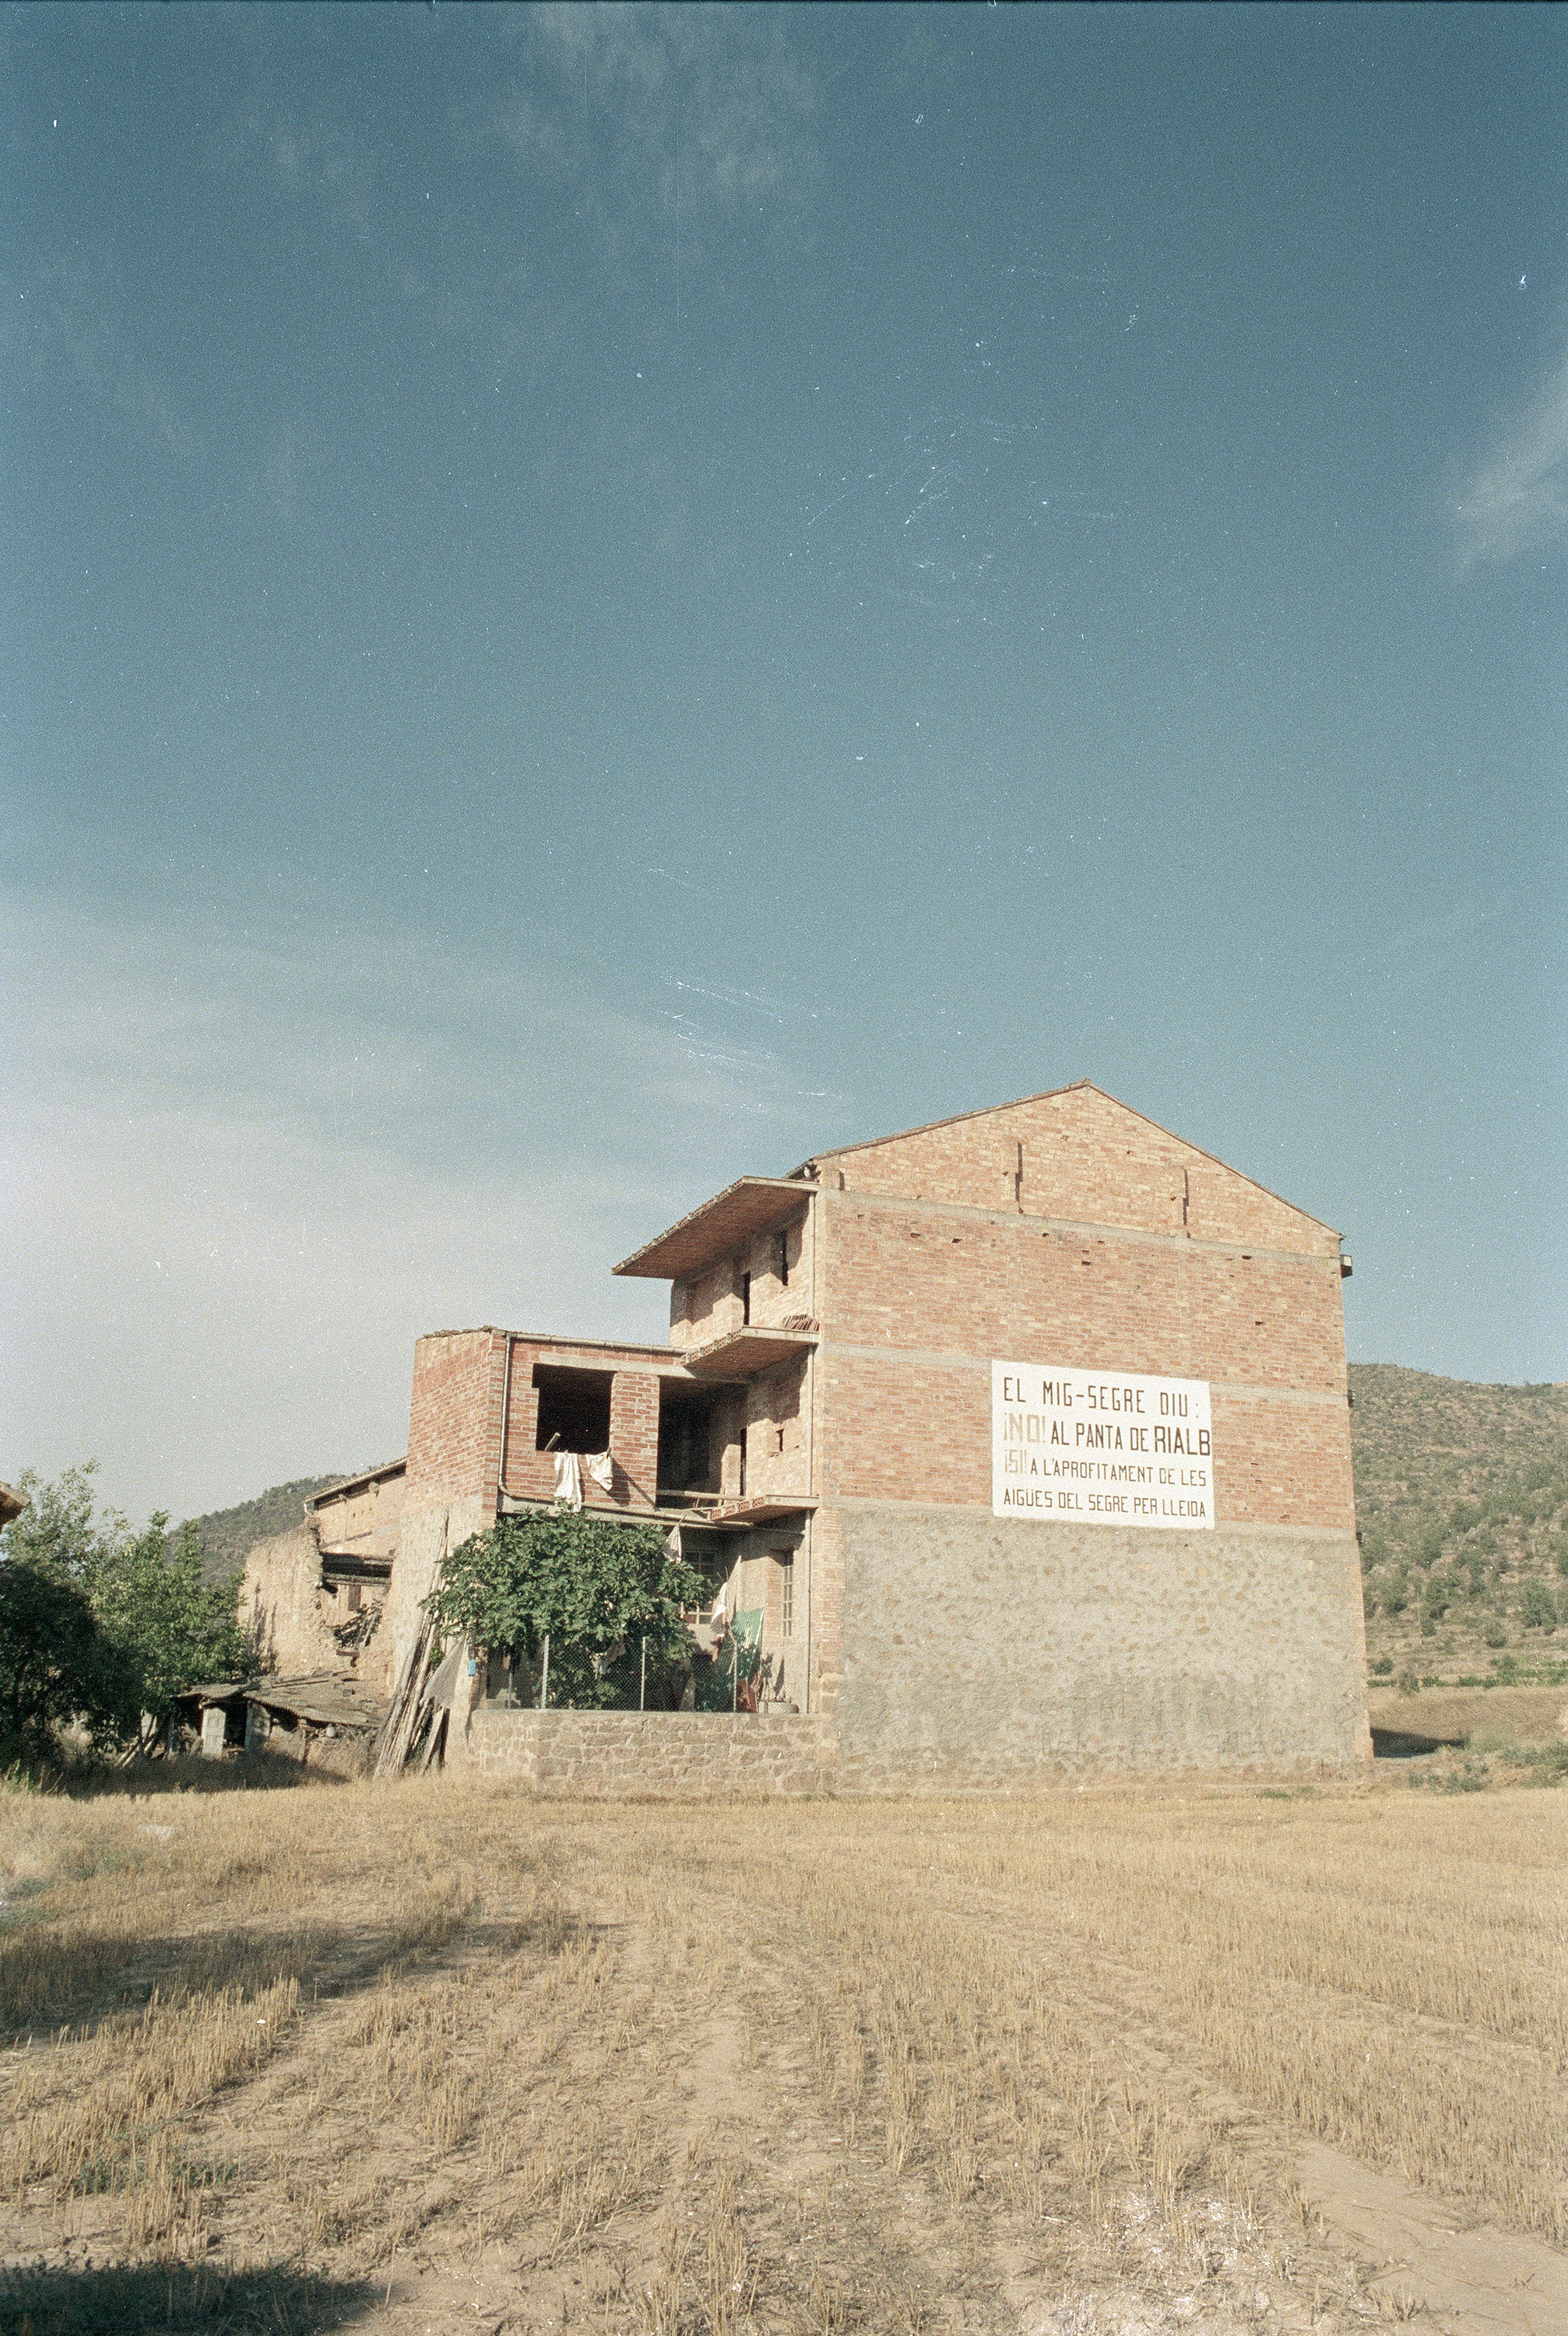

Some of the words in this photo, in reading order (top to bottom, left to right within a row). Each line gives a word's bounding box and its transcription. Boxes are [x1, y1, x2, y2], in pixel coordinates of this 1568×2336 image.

[1004, 1377, 1026, 1402] EL
[1042, 1381, 1145, 1413] MIG-SEGRE
[1004, 1413, 1046, 1444] ¡NO!
[1051, 1420, 1070, 1445] AL
[1076, 1423, 1123, 1450] PANTA
[1130, 1427, 1148, 1451] DE
[1154, 1426, 1210, 1456] RIALB
[1031, 1458, 1037, 1475] A
[1043, 1458, 1153, 1483] L'APROFITAMENT
[1159, 1468, 1175, 1484] DE
[1181, 1470, 1206, 1486] LES
[1004, 1488, 1053, 1507] AIGÜES
[1059, 1492, 1082, 1510] DEL
[1089, 1494, 1128, 1513] SEGRE
[1134, 1497, 1157, 1515] PER
[1163, 1499, 1205, 1517] LLEIDA
